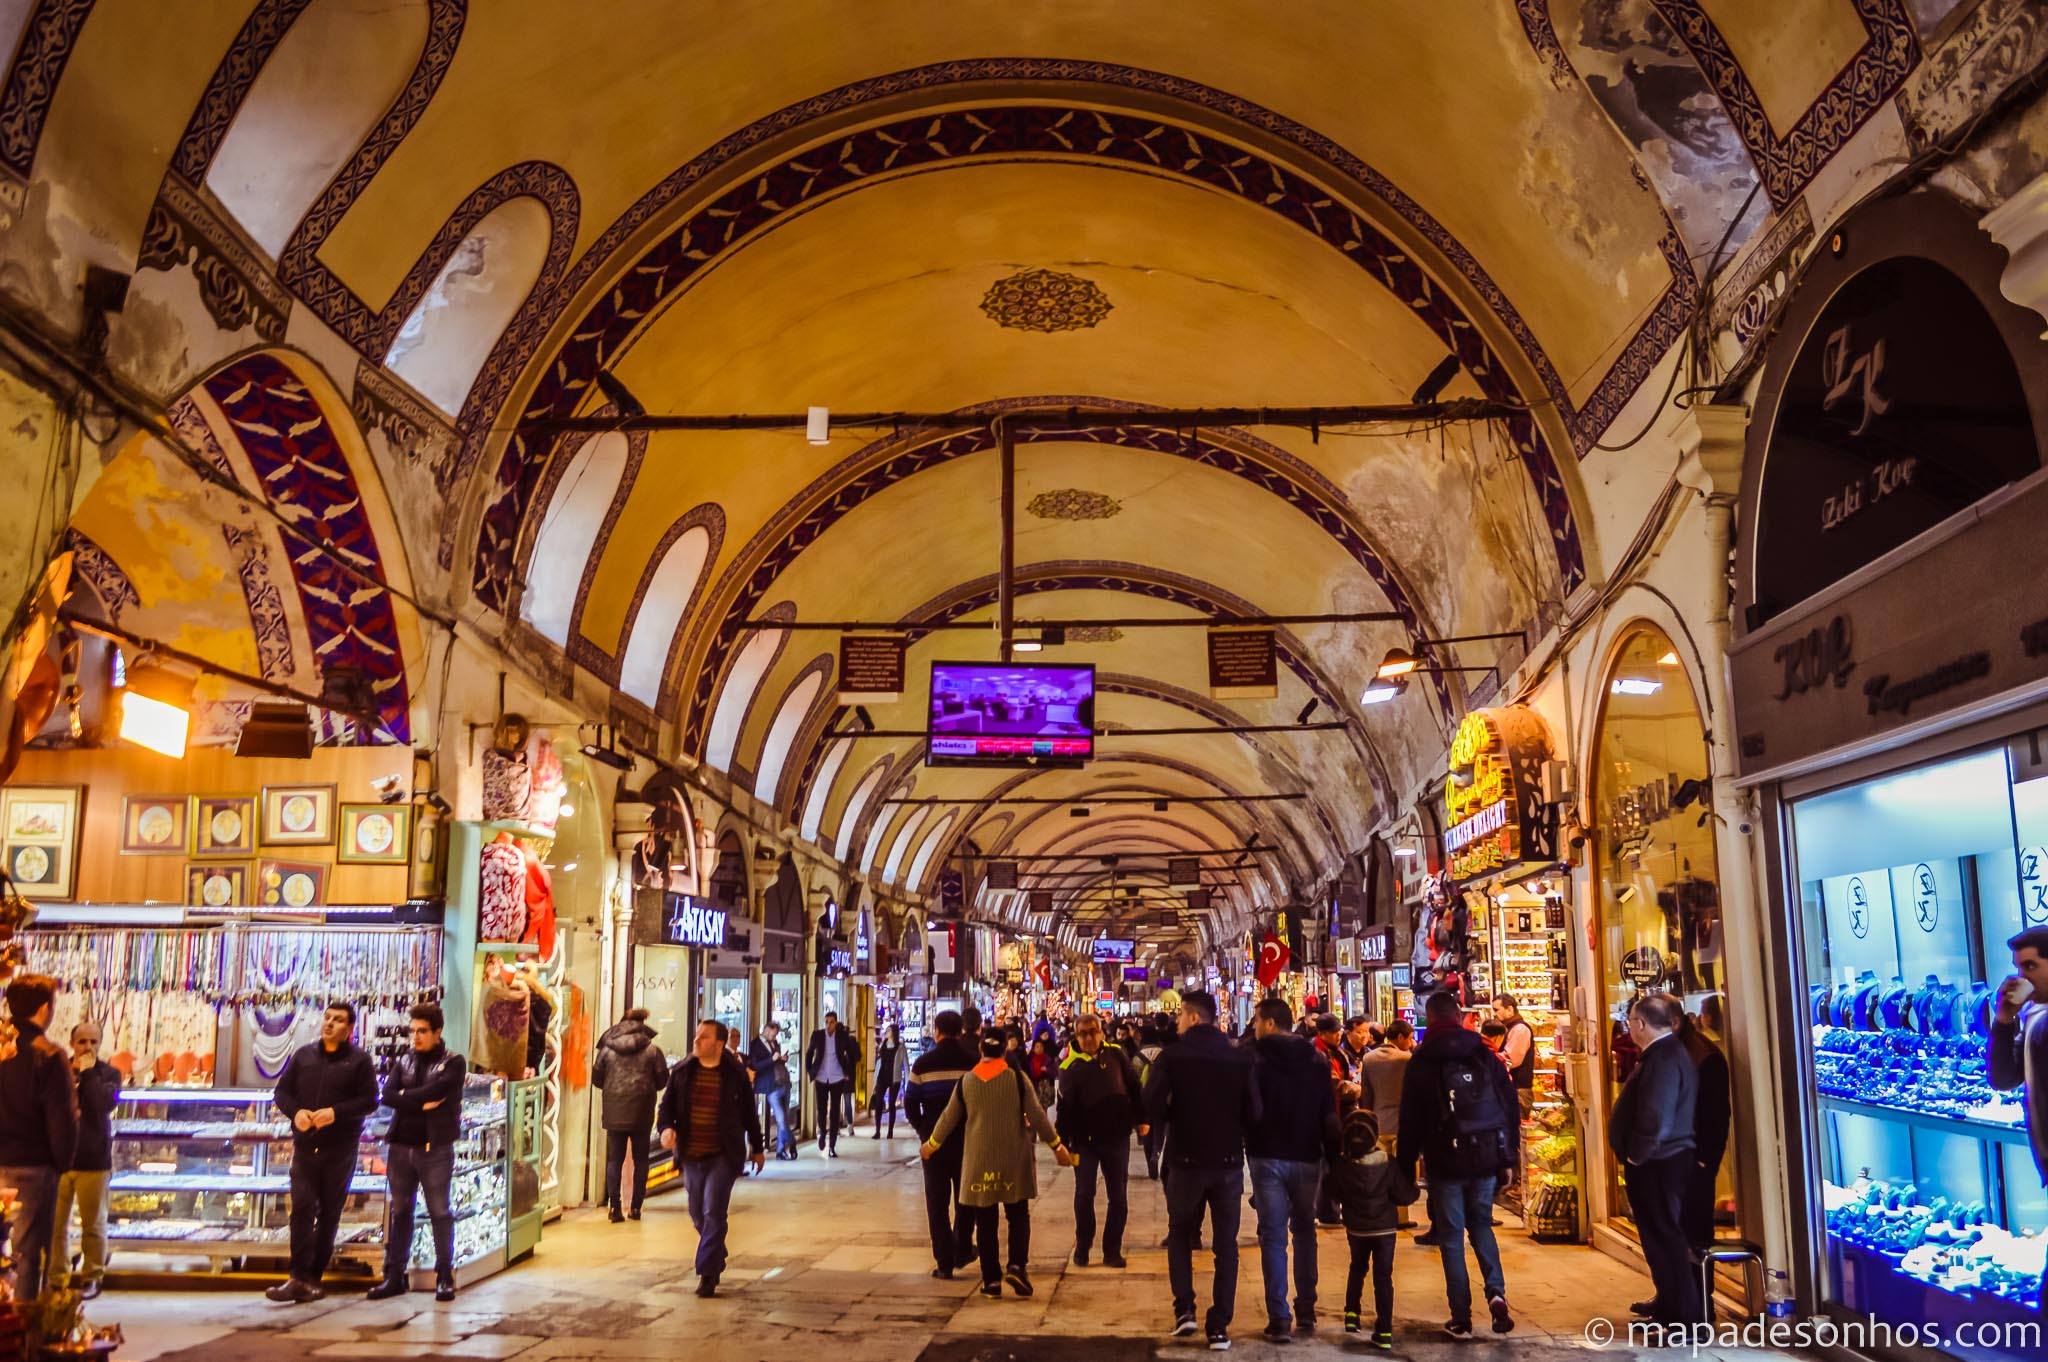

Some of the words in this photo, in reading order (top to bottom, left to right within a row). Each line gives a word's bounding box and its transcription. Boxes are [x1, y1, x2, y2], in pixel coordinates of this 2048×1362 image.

[1822, 480, 1861, 531] Zeki
[1473, 799, 1507, 838] DELIGHT
[671, 896, 726, 944] ATASAY
